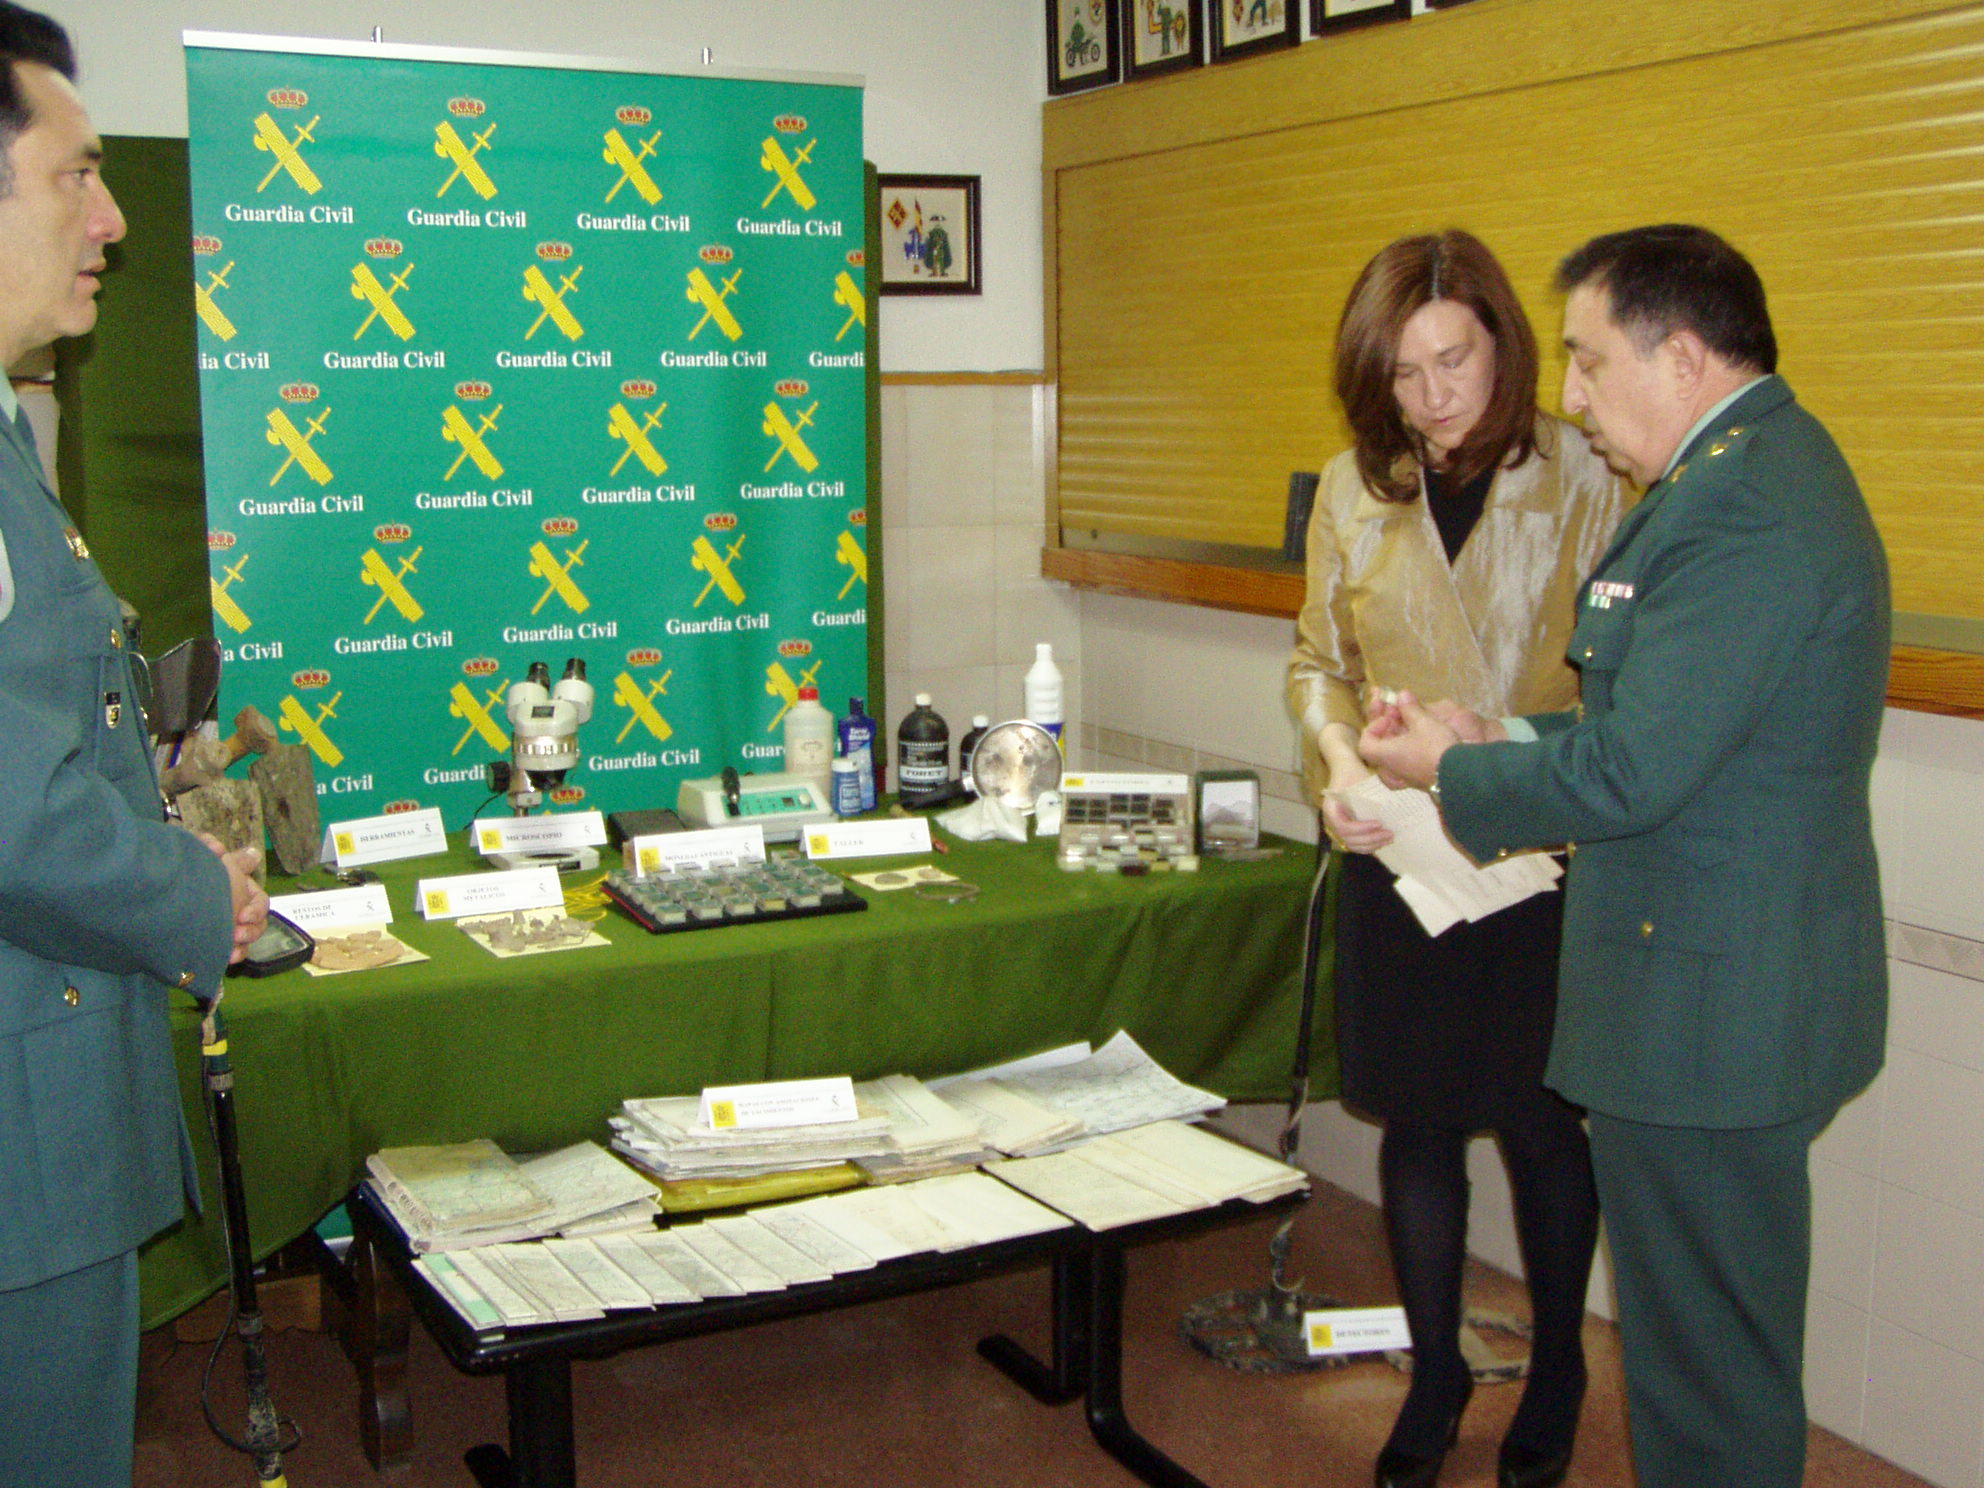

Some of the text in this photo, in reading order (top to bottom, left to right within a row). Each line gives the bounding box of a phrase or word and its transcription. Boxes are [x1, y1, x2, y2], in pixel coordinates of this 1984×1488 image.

[224, 203, 355, 225] Guardia Civil
[406, 207, 528, 228] Guardia Civil
[576, 213, 691, 232] Guardia Civil
[736, 217, 843, 237] Guardia Civil
[223, 351, 271, 370] Civil
[322, 350, 446, 369] Guardia Civil
[495, 349, 613, 368] Guardia Civil
[659, 350, 768, 368] Guardia Civil
[808, 351, 865, 368] Guardi
[415, 489, 533, 509] Guardia Civil
[581, 485, 696, 504] Guardia Civil
[740, 481, 845, 499] Guardia Civil
[238, 495, 364, 516] Guardia Civil
[665, 613, 770, 635] Guardia Civil
[811, 608, 866, 627] Guardi
[502, 621, 618, 643] Guardia Civil
[239, 641, 284, 661] Civil
[333, 631, 453, 654] Guardia Civil
[588, 749, 700, 771] Guardia Civil
[331, 773, 374, 793] Civil
[423, 764, 486, 785] Guardi
